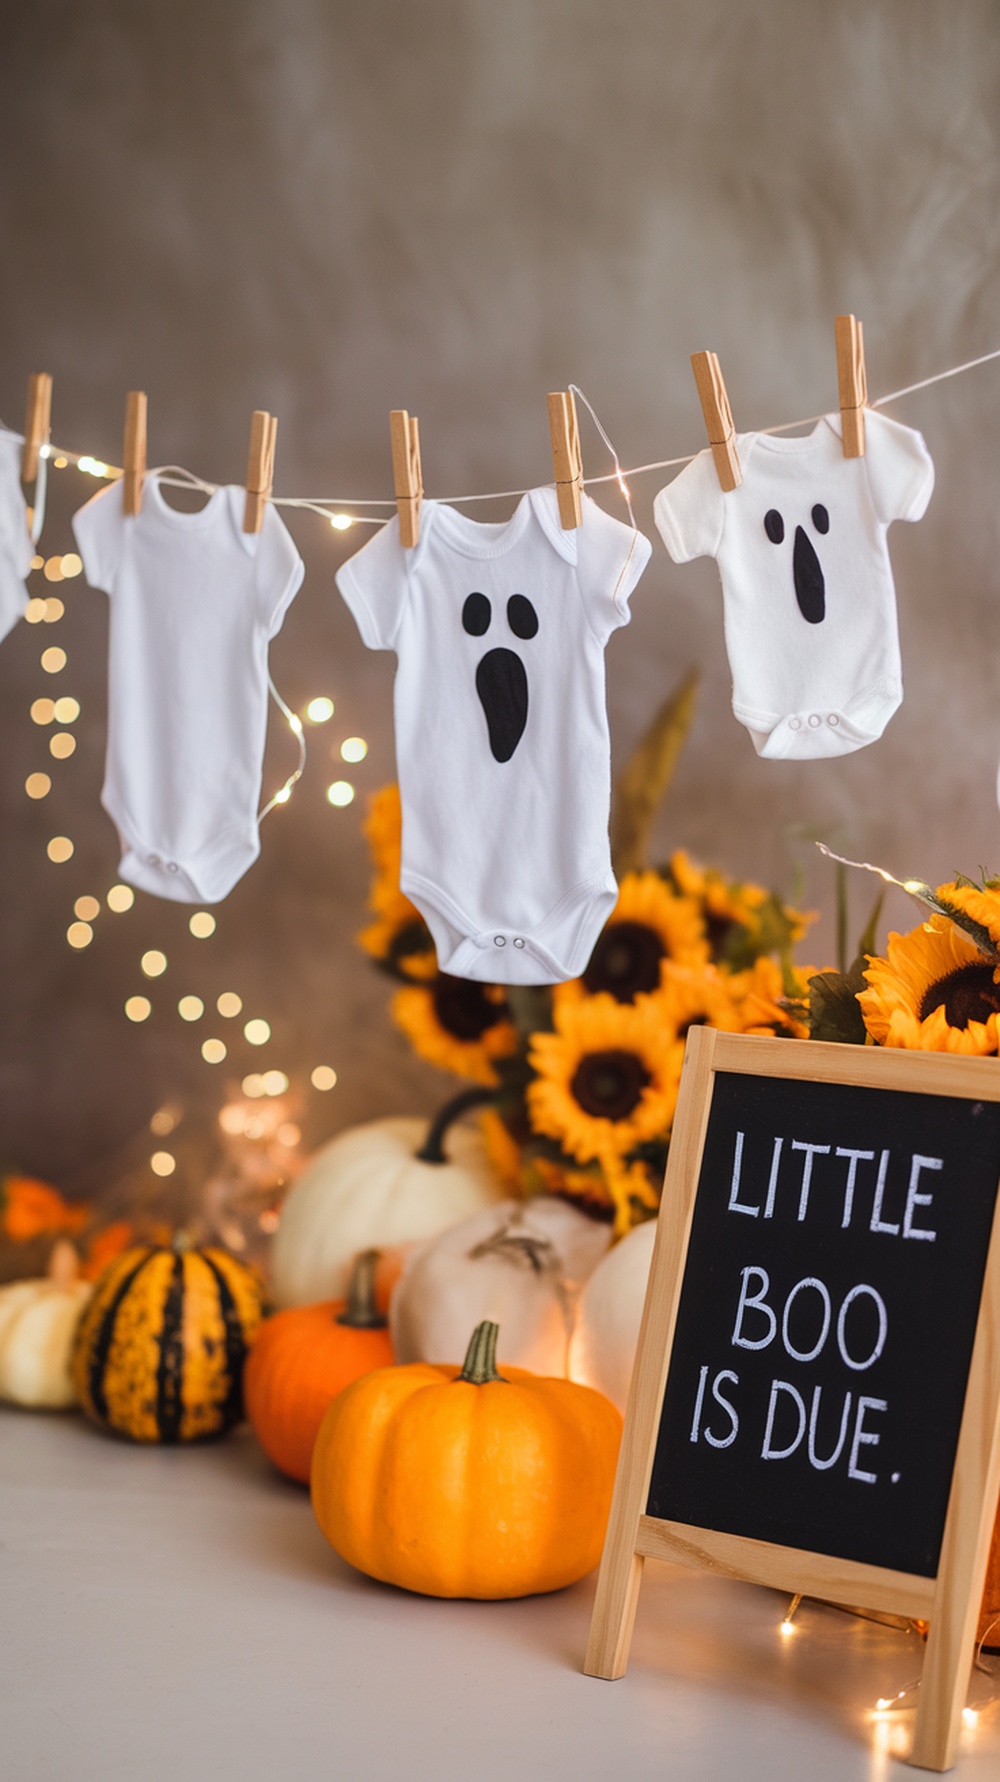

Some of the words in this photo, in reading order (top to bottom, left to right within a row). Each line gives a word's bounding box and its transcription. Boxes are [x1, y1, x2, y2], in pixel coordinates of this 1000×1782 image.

[727, 1131, 943, 1242] LITTLE
[731, 1266, 888, 1371] BOO
[689, 1366, 740, 1449] IS
[761, 1380, 901, 1484] DUE.
